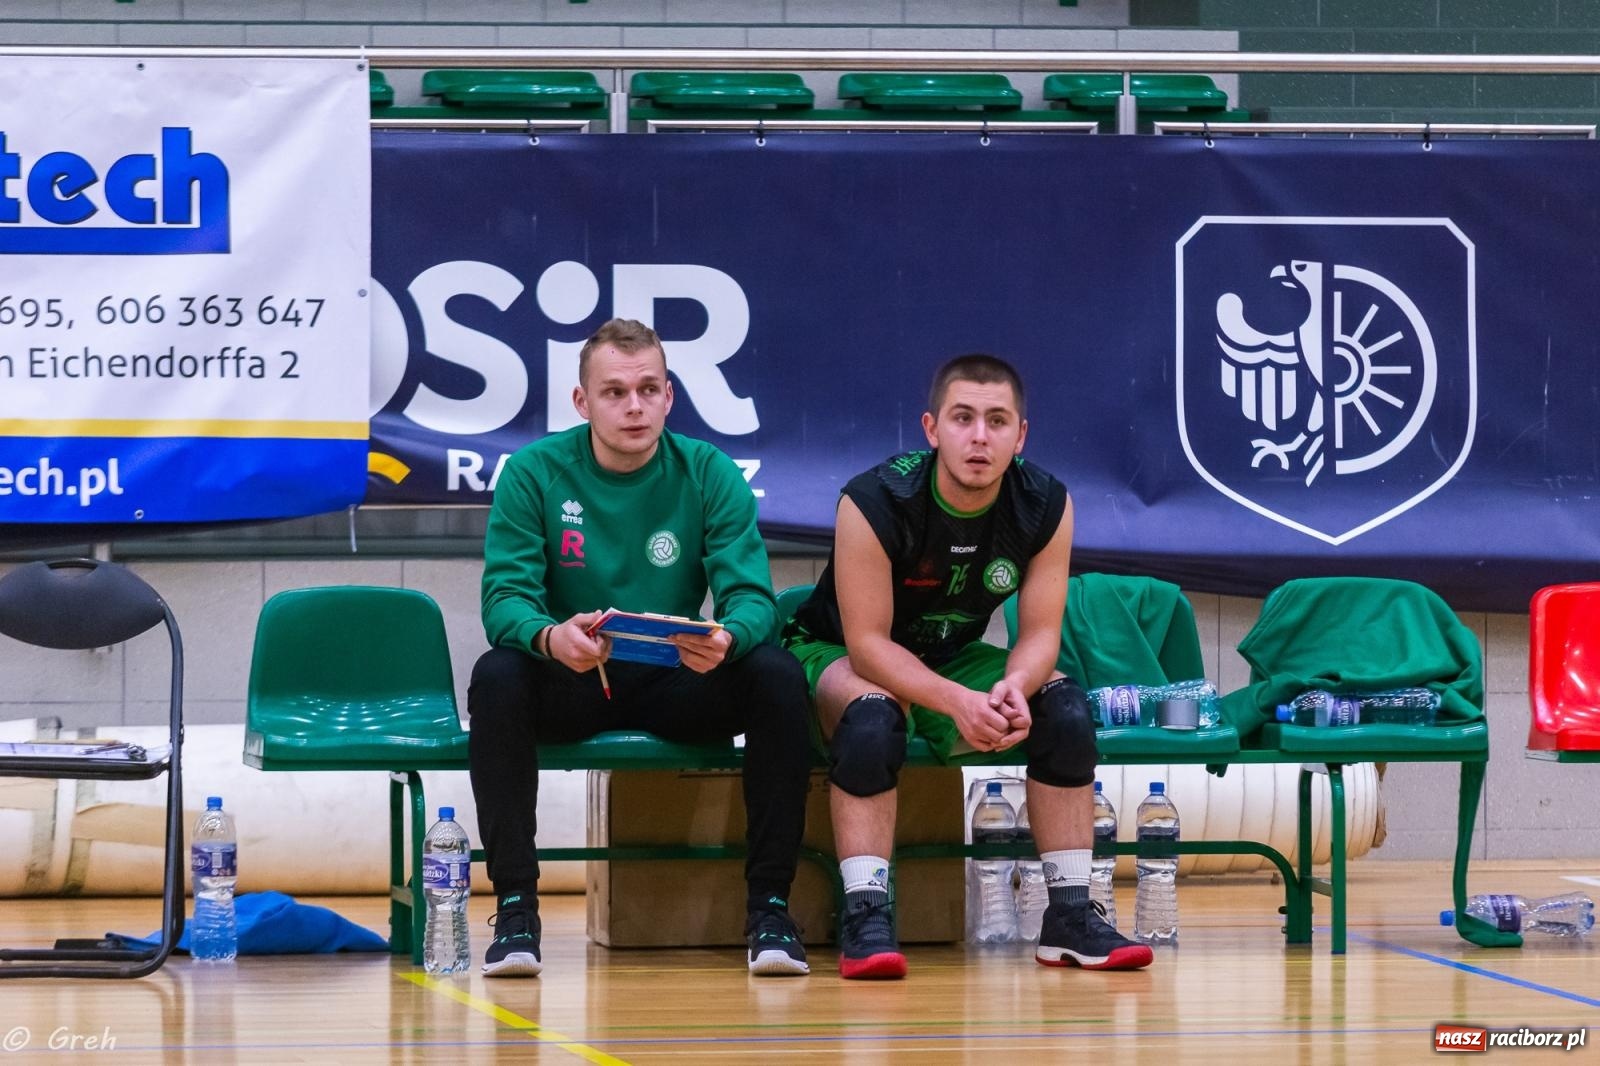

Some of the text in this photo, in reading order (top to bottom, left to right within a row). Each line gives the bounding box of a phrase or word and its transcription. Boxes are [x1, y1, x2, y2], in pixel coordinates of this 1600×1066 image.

[96, 295, 165, 325] 606
[178, 294, 244, 327] 363
[258, 295, 325, 328] 647
[29, 346, 266, 379] Eichendorffa
[280, 350, 300, 379] 2
[370, 260, 760, 435] SiR
[561, 529, 585, 558] R
